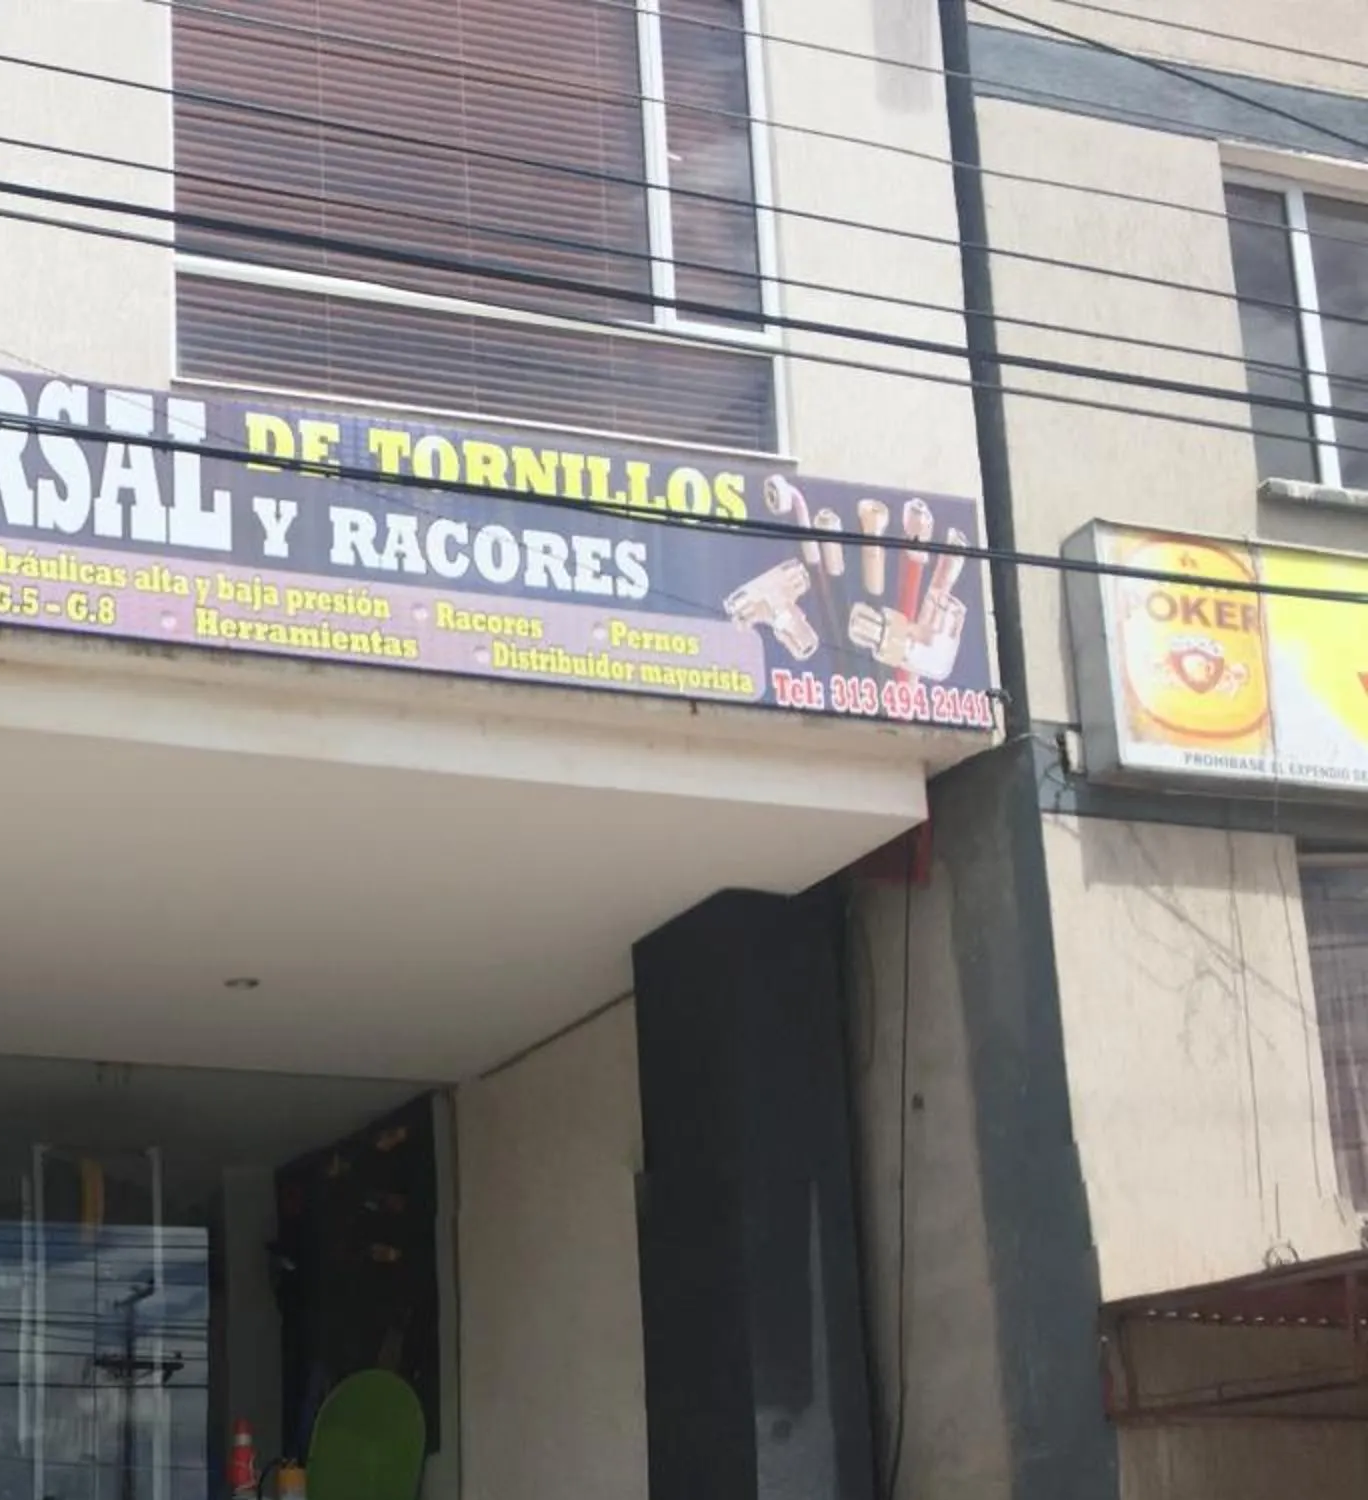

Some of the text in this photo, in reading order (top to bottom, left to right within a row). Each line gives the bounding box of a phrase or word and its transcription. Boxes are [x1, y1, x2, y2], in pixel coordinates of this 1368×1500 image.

[245, 412, 748, 528] DE TORNILLOS
[253, 497, 649, 600] Y RACORES
[133, 564, 189, 596] alta
[195, 576, 211, 604] y
[216, 573, 279, 613] baja
[287, 588, 390, 619] presión
[1124, 588, 1261, 633] OKER
[195, 606, 419, 660] Herramientas
[437, 602, 543, 638] Racores
[609, 622, 700, 655] Pernos
[492, 642, 754, 694] Distribuidor mayorista
[772, 669, 825, 709] Tel:
[831, 674, 879, 716] 313
[882, 681, 929, 721] 494
